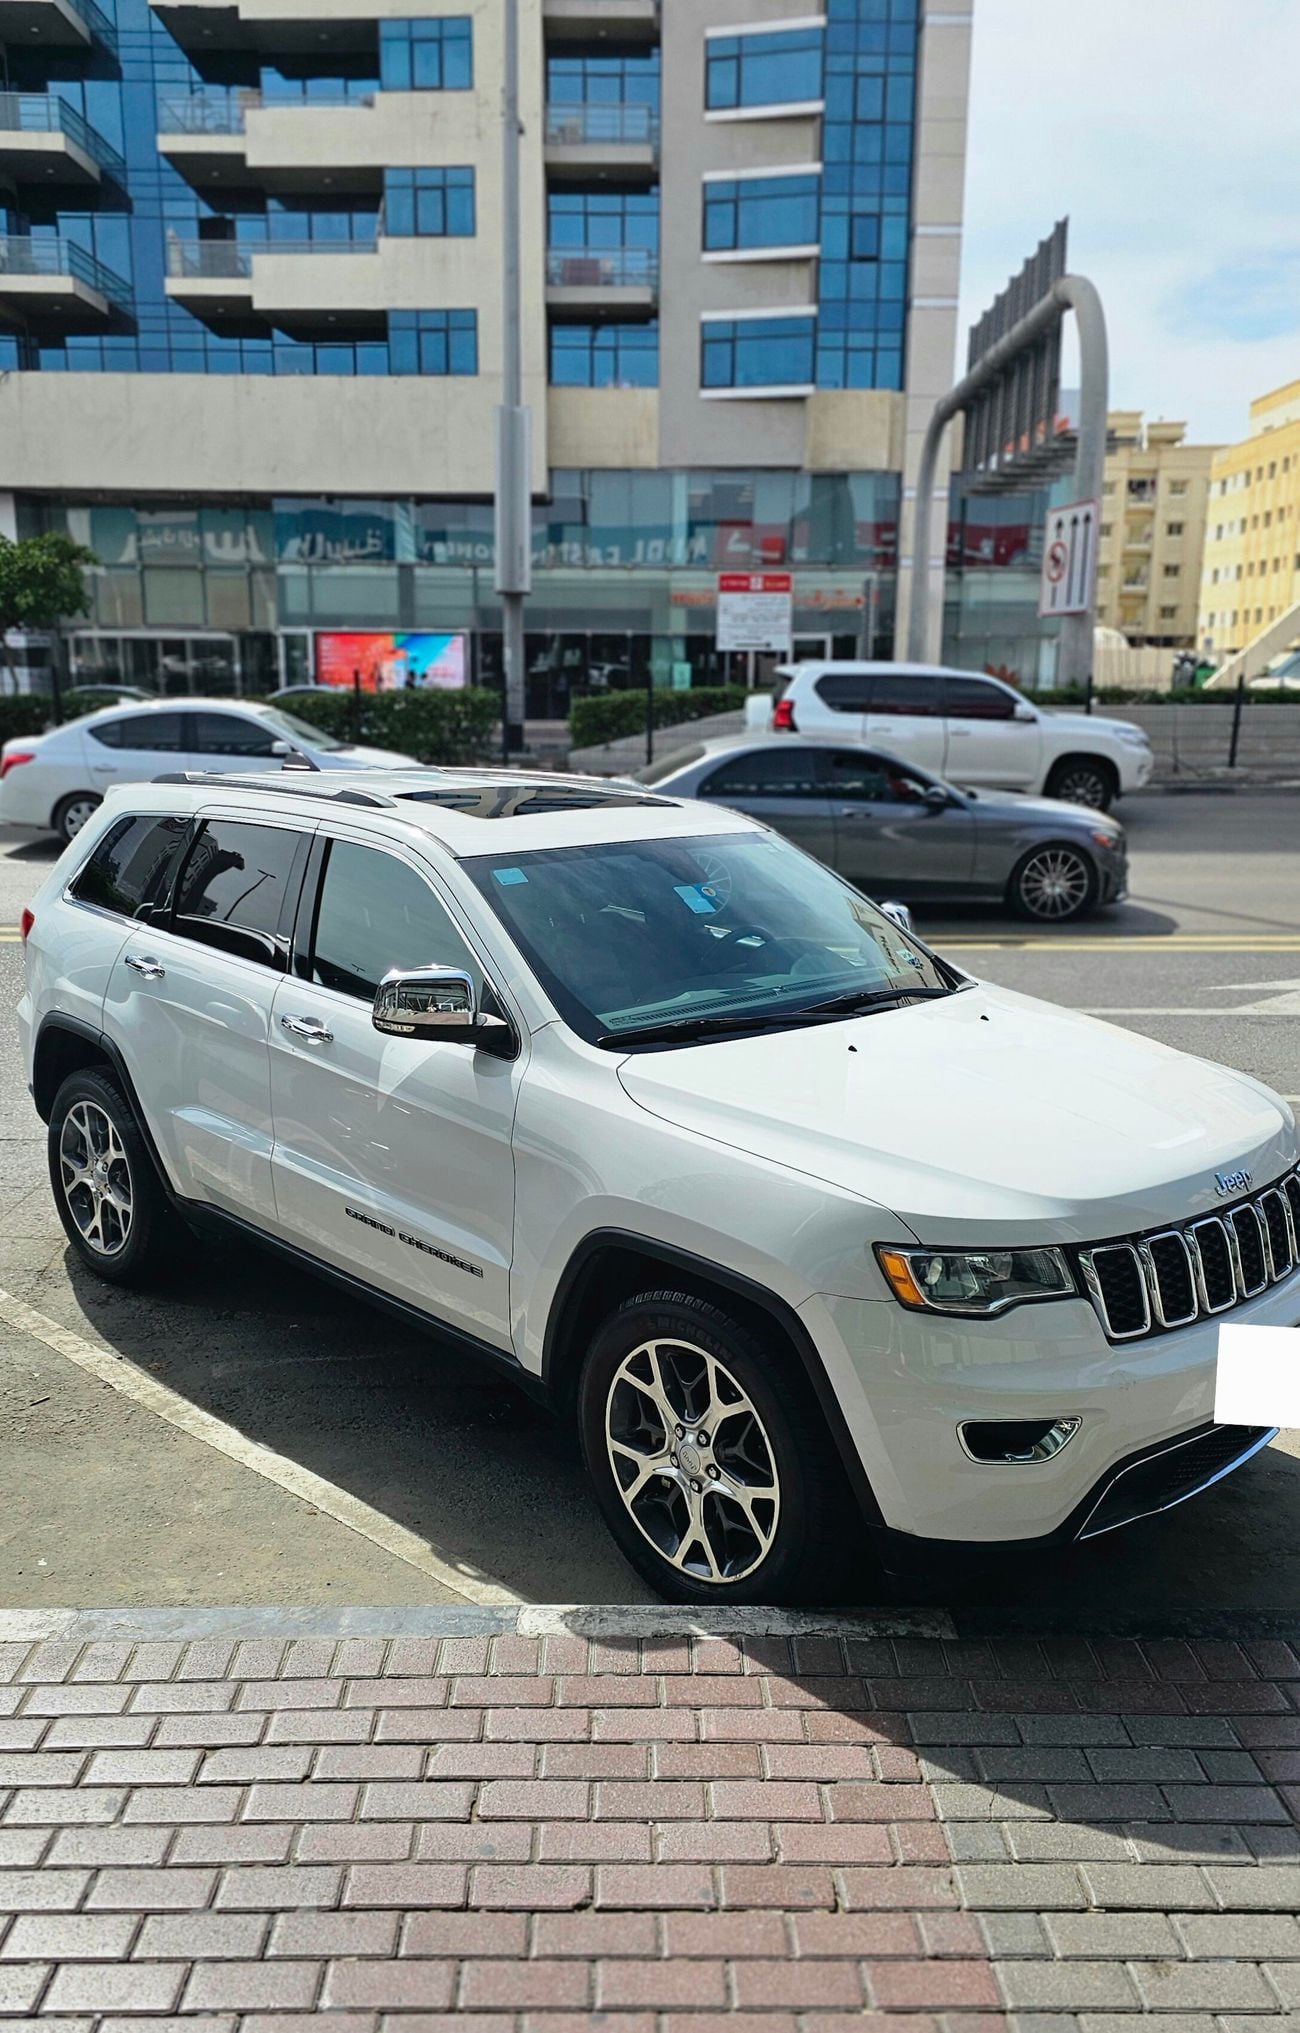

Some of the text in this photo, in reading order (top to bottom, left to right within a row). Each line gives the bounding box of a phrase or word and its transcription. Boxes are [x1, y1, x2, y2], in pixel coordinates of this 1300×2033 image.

[1214, 1168, 1253, 1197] Jeep
[344, 1206, 484, 1279] GRAND CHEROKEE
[657, 1316, 733, 1361] MICHELIN
